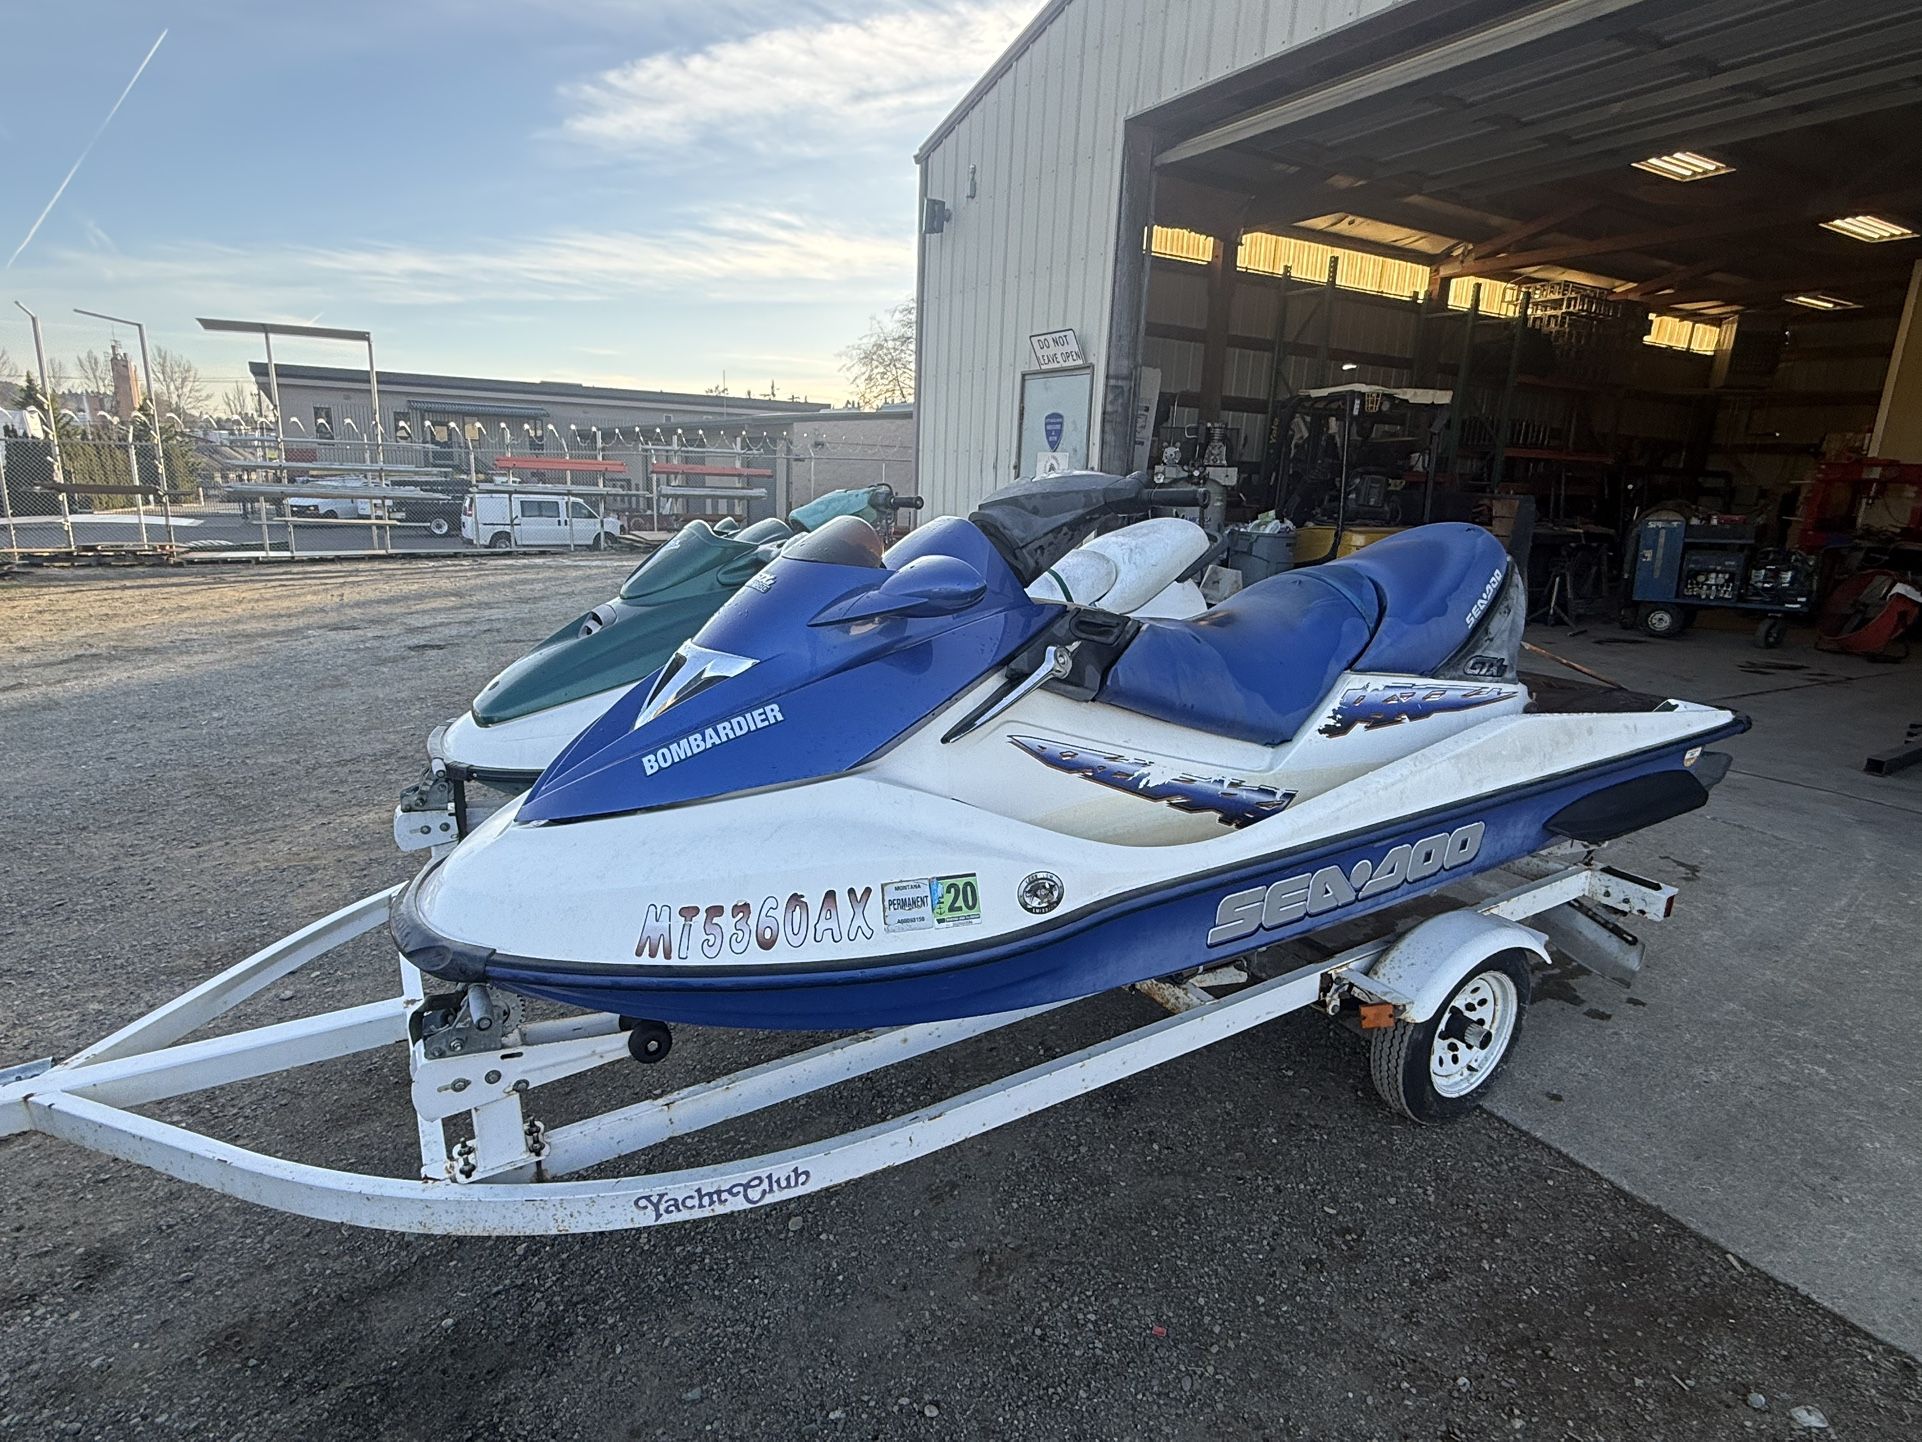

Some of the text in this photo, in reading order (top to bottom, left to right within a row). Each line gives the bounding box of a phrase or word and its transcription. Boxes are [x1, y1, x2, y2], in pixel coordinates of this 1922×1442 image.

[1037, 334, 1069, 350] DO NOT
[1038, 350, 1081, 366] LEAVE OPEN
[641, 703, 785, 776] BOMBARDIER
[894, 884, 922, 892] MONTANA
[888, 895, 930, 912] PERMANENT
[945, 881, 978, 913] 20
[633, 1166, 812, 1222] Yacht Club
